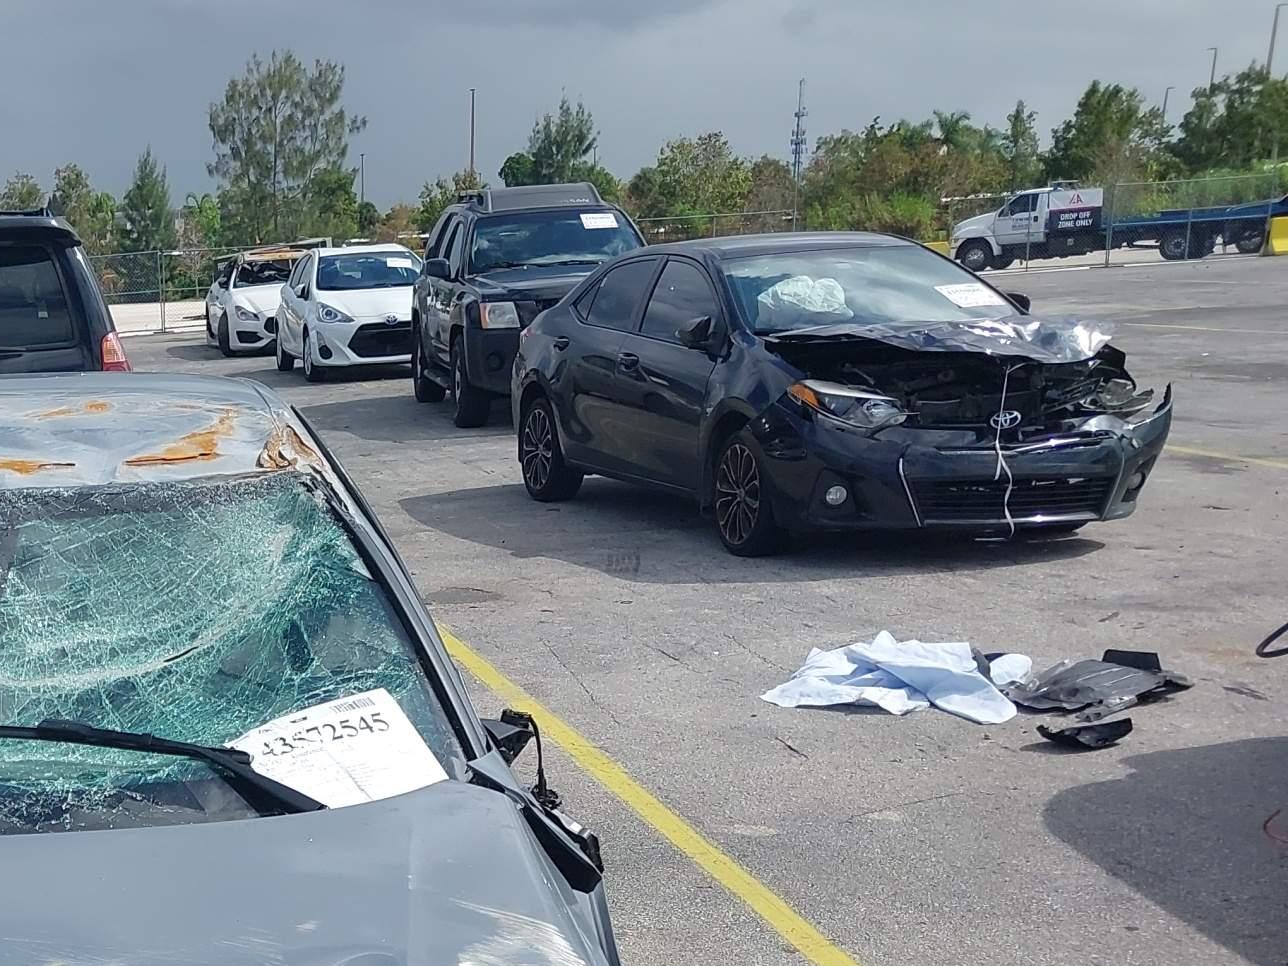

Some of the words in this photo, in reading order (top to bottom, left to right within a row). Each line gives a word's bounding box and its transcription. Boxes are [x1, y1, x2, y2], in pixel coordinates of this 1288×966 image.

[1078, 211, 1091, 219] OFF
[1057, 221, 1075, 229] ZONE
[1075, 218, 1094, 227] ONLY
